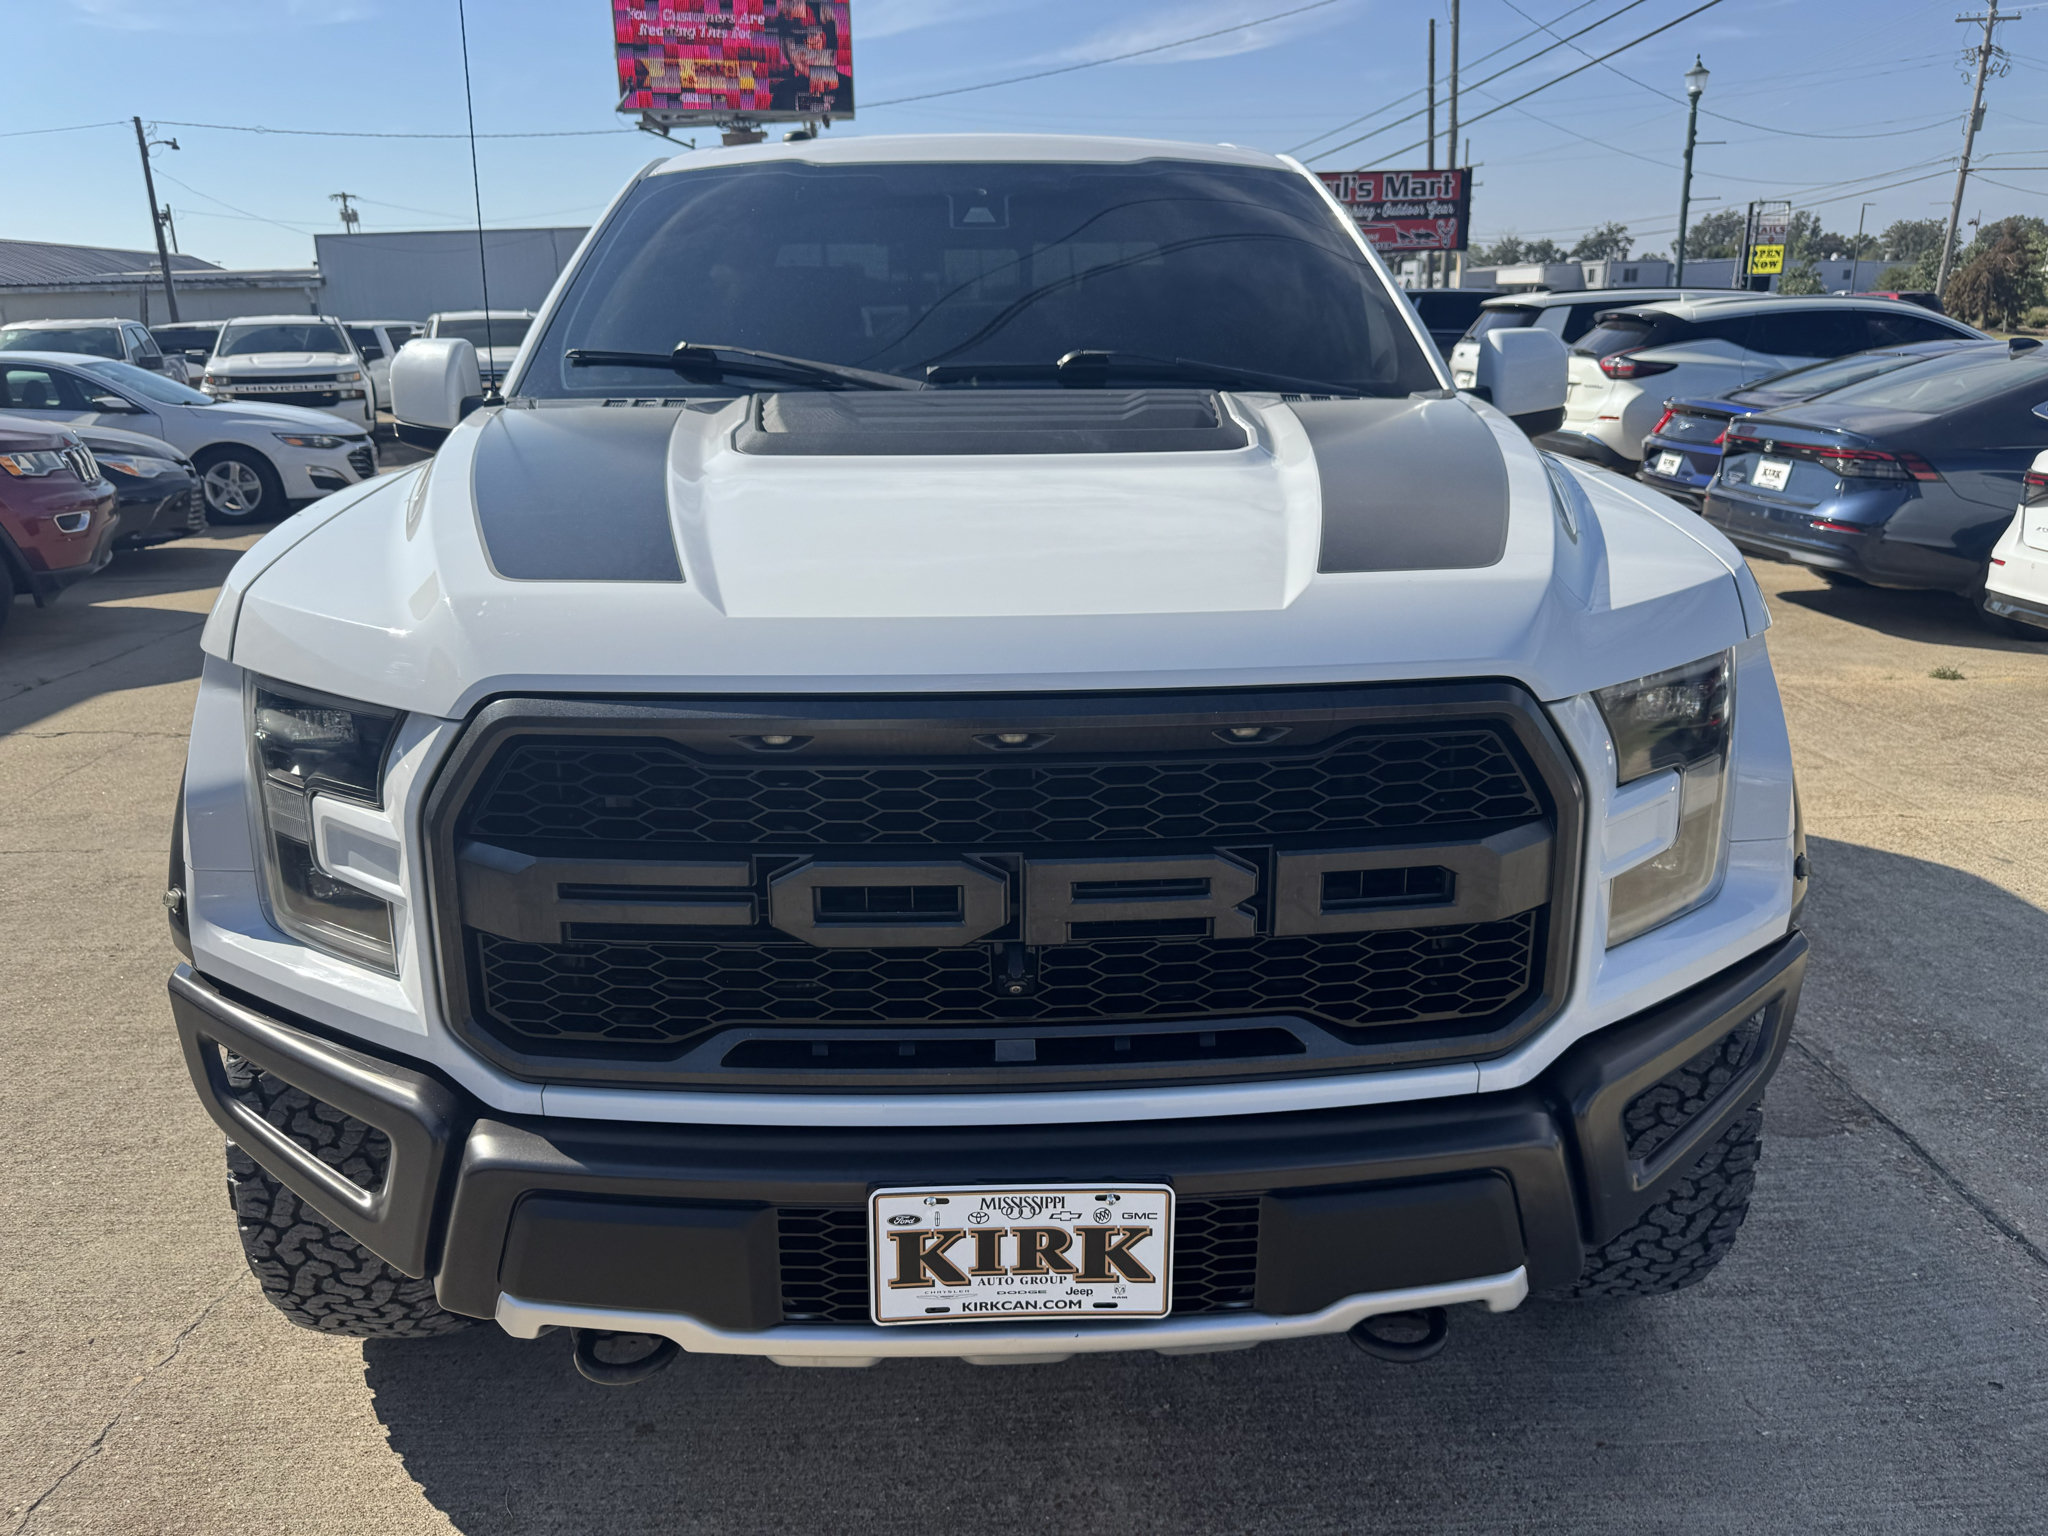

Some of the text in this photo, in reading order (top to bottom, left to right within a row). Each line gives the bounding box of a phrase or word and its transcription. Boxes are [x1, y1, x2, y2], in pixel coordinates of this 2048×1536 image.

[663, 9, 736, 24] Customers
[739, 12, 766, 25] Are
[1322, 172, 1455, 201] ul's Mart
[1382, 201, 1426, 217] Outdoor
[1426, 201, 1456, 219] Gear
[234, 383, 335, 393] CHEVROLET
[1762, 467, 1783, 479] KIRK
[458, 820, 1552, 948] FORD
[980, 1195, 1066, 1220] MISSISSIPPI
[1121, 1211, 1158, 1221] GMC
[887, 1225, 1156, 1289] KIRK
[977, 1275, 1068, 1286] AUTO GROUP
[1065, 1286, 1094, 1297] Jeep
[962, 1299, 1082, 1313] KIRKCAN.COM
